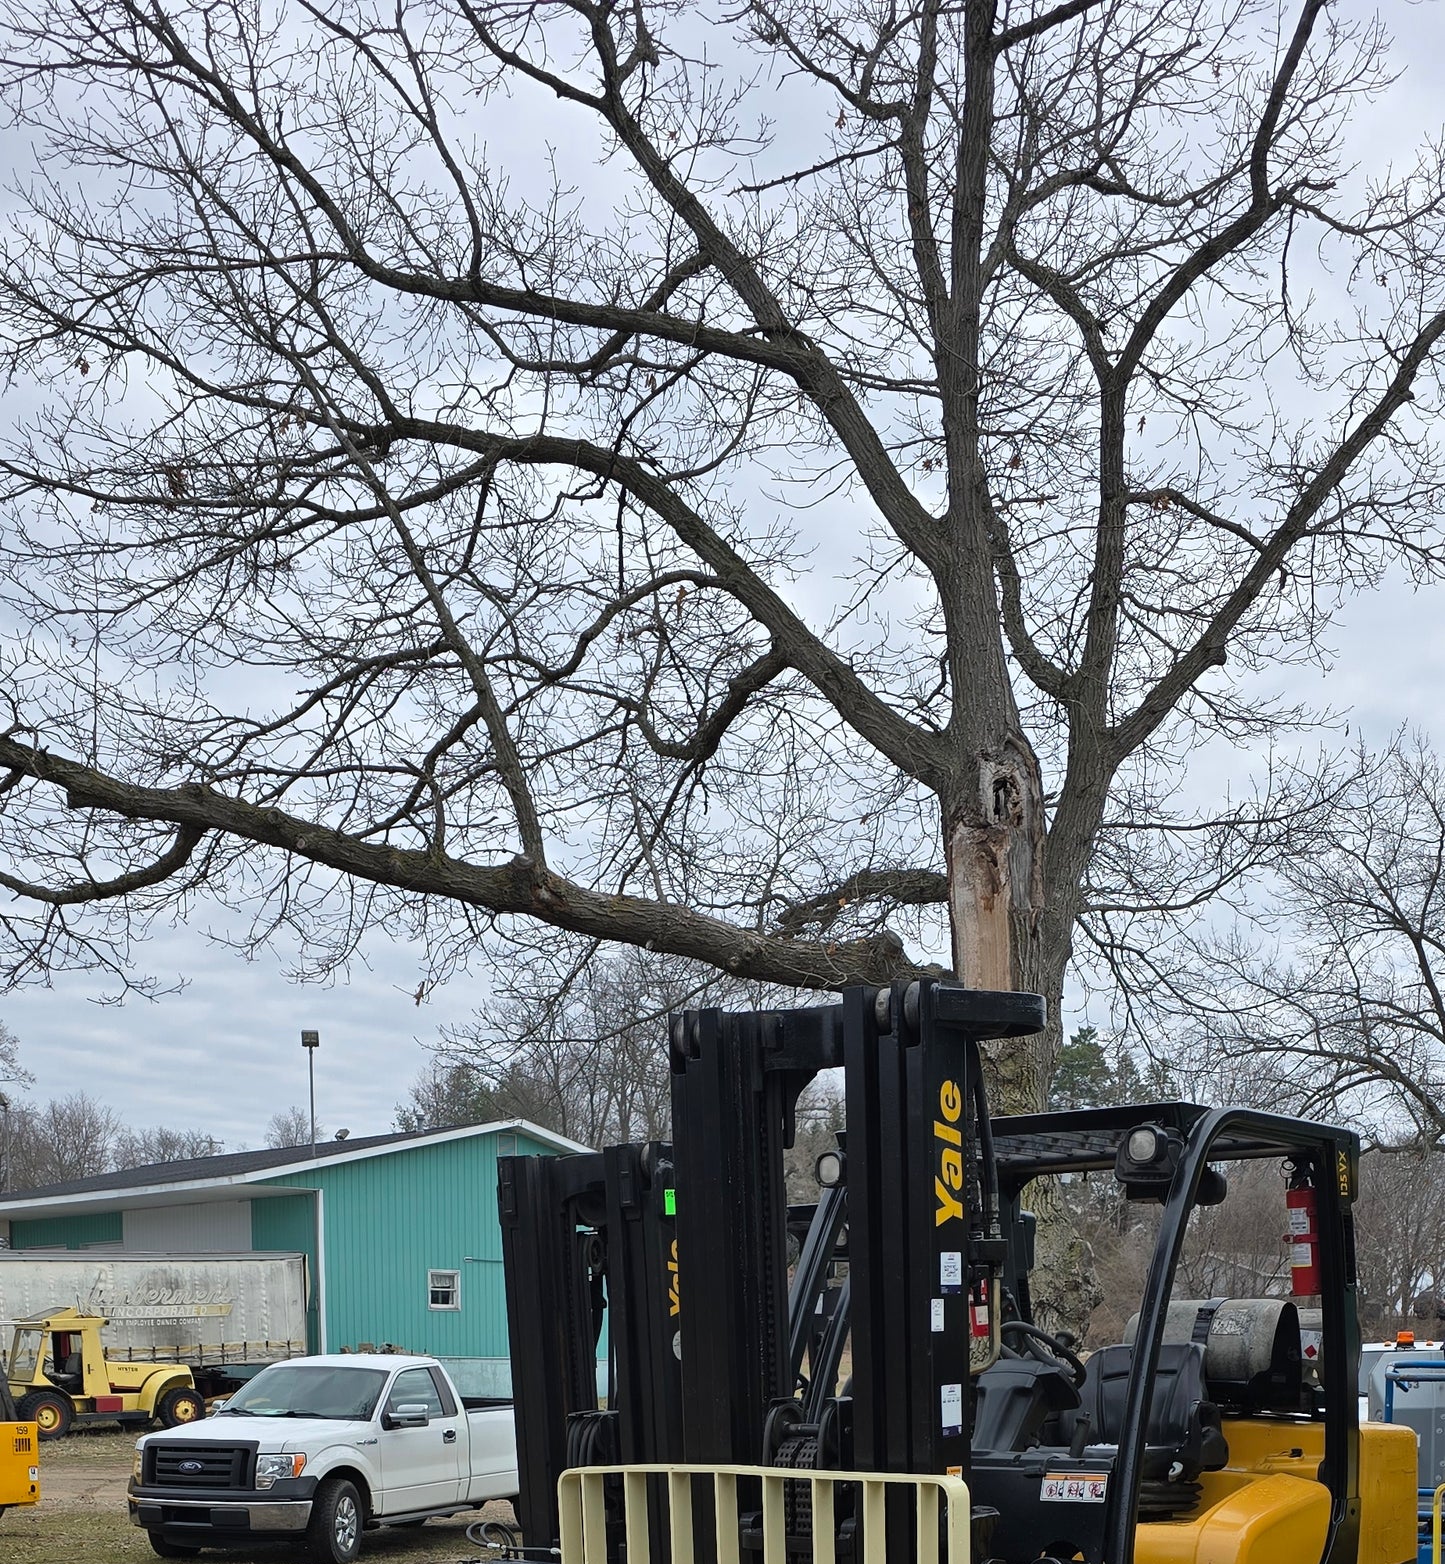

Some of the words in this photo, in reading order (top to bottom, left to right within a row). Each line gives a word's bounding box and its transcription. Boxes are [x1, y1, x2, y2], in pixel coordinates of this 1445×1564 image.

[934, 1080, 963, 1227] Yale
[112, 1306, 208, 1317] INCORPORATED
[16, 1426, 29, 1435] 159
